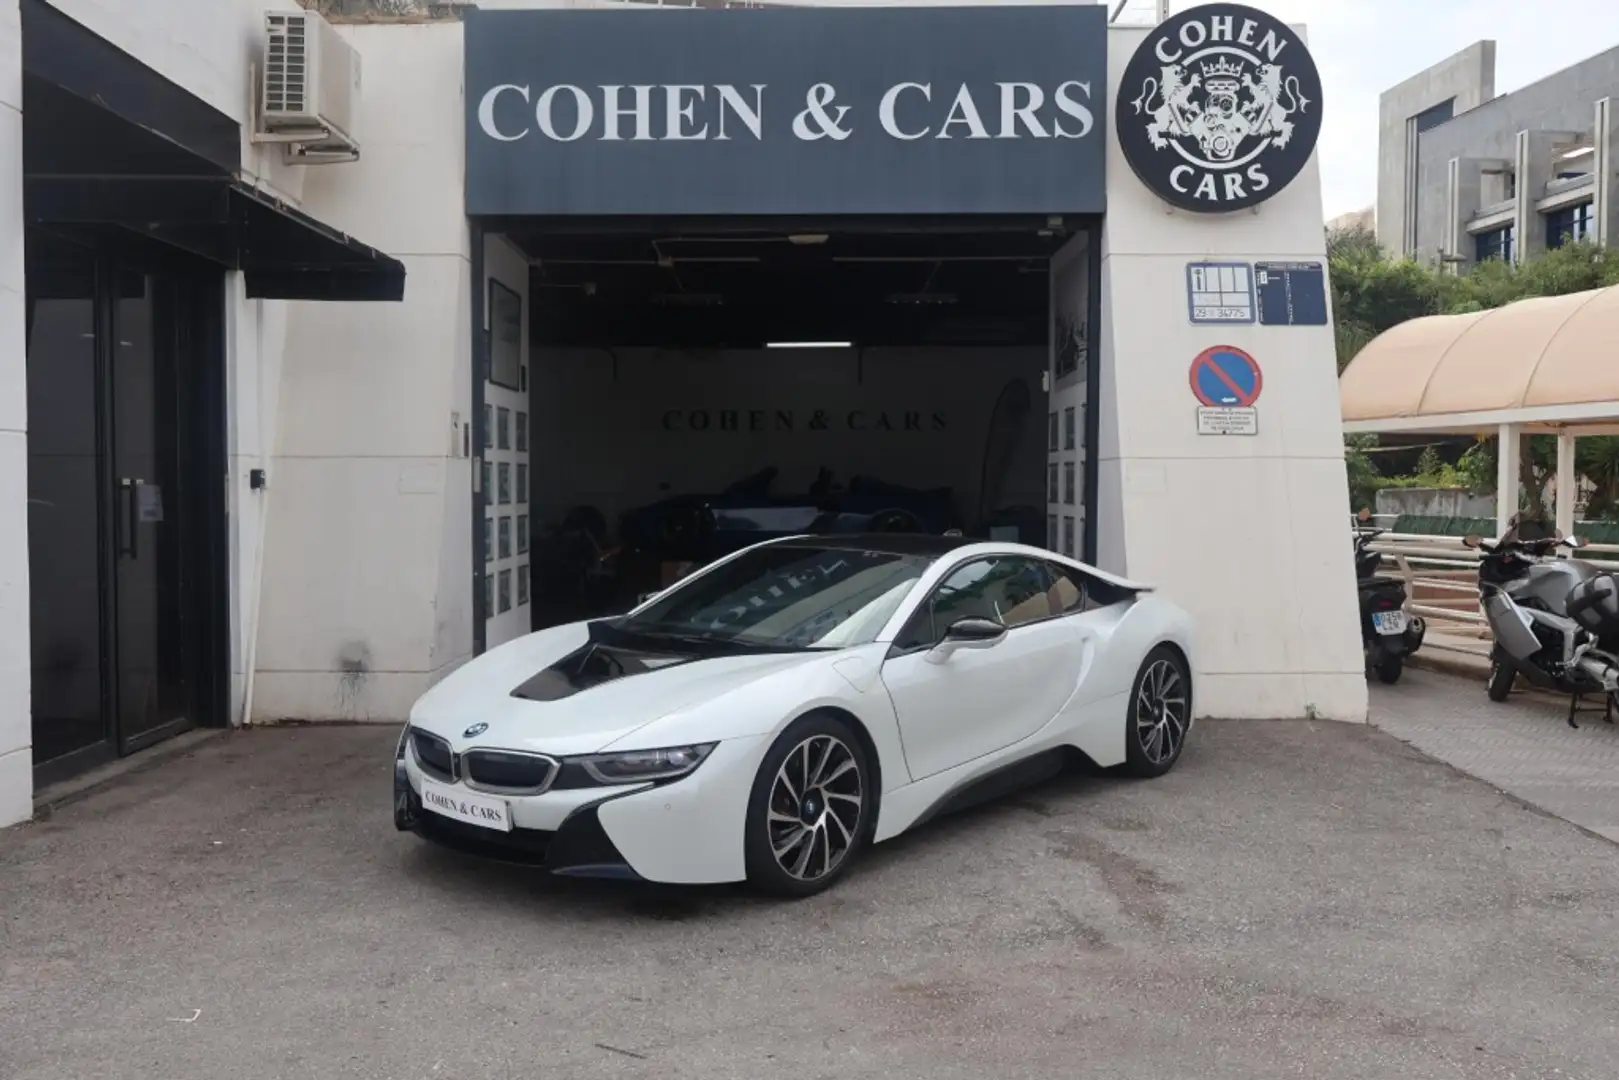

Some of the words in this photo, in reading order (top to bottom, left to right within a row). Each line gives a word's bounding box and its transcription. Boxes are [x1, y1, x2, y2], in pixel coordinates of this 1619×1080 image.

[1155, 15, 1287, 63] COHEN
[478, 84, 766, 141] COHEN
[792, 83, 852, 140] &
[879, 81, 1093, 139] CARS
[1169, 163, 1270, 201] CARS
[661, 409, 795, 432] COHEN
[808, 409, 830, 431] &
[846, 409, 948, 432] CARS
[425, 790, 458, 812] COHEN
[460, 802, 469, 816] &
[470, 804, 502, 822] CARS
